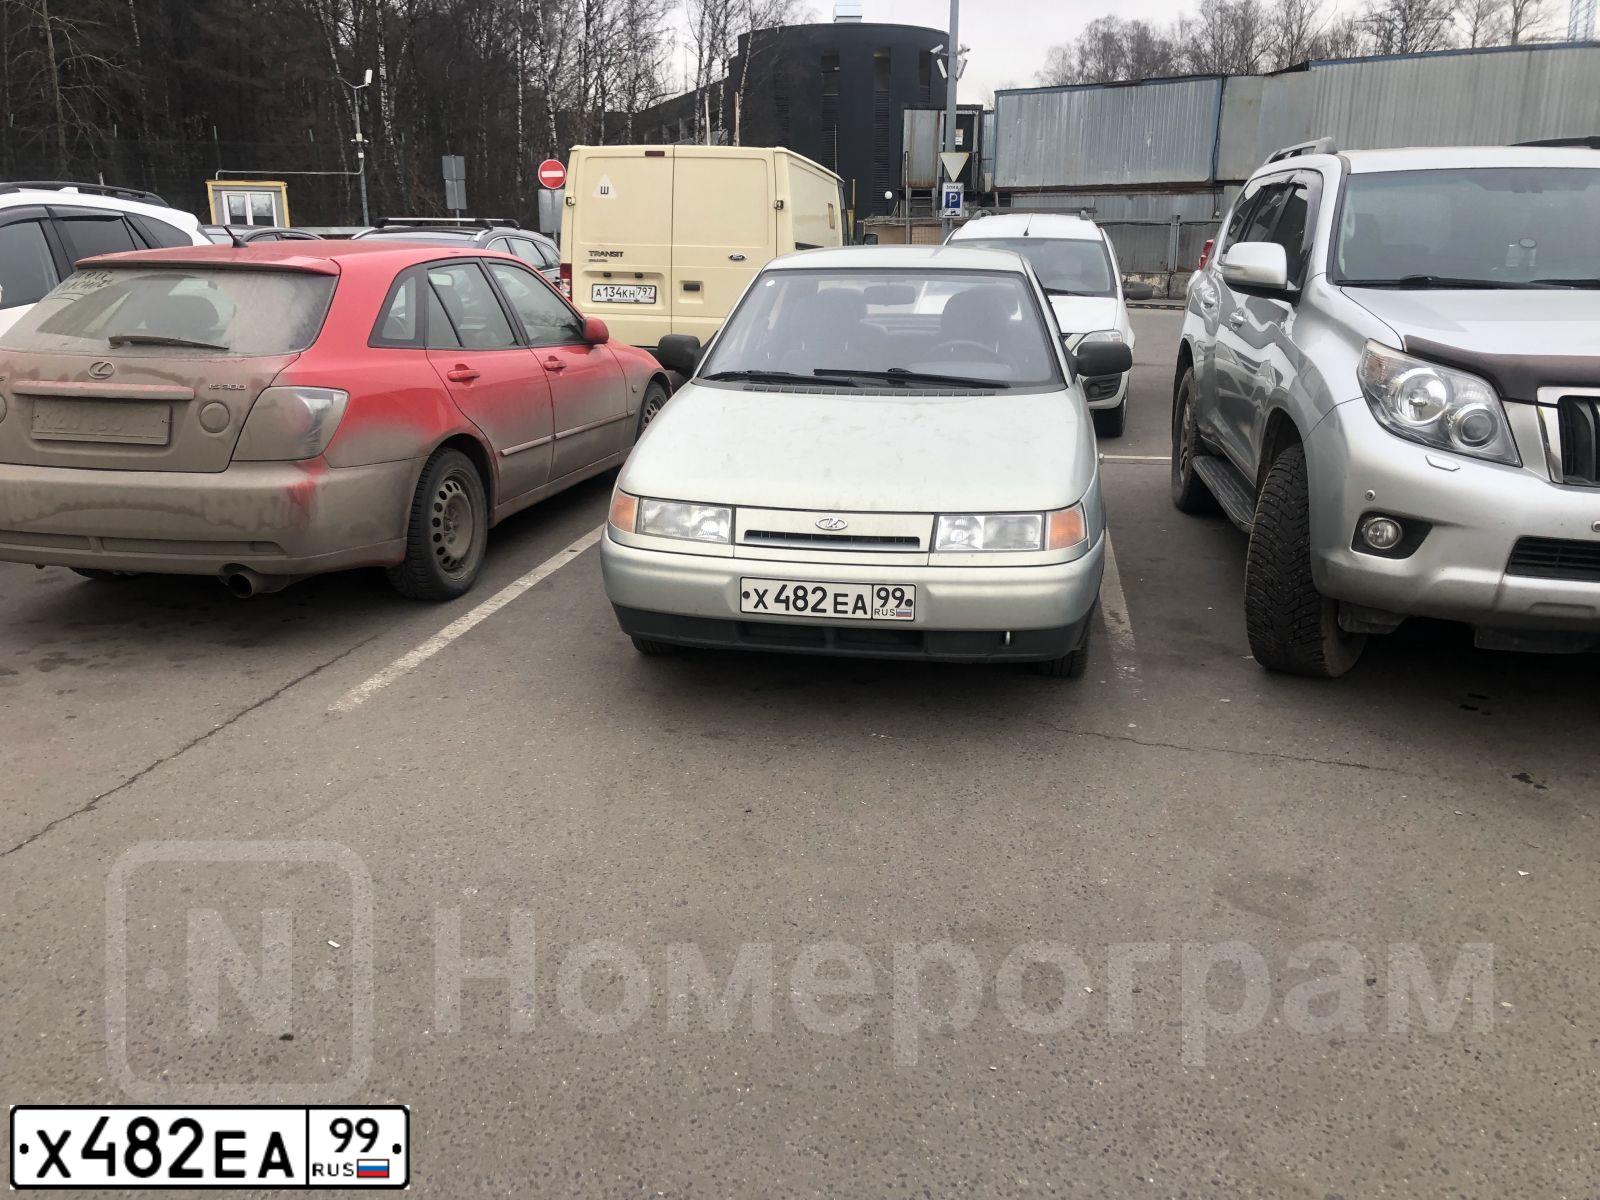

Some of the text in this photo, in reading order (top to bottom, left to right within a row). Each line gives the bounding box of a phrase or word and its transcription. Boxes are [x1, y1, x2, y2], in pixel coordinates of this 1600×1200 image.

[600, 186, 609, 195] Ш
[588, 250, 624, 258] TRANSIT
[637, 287, 653, 296] 797
[753, 583, 905, 616] Х482ЕА 99
[874, 608, 896, 617] RUS
